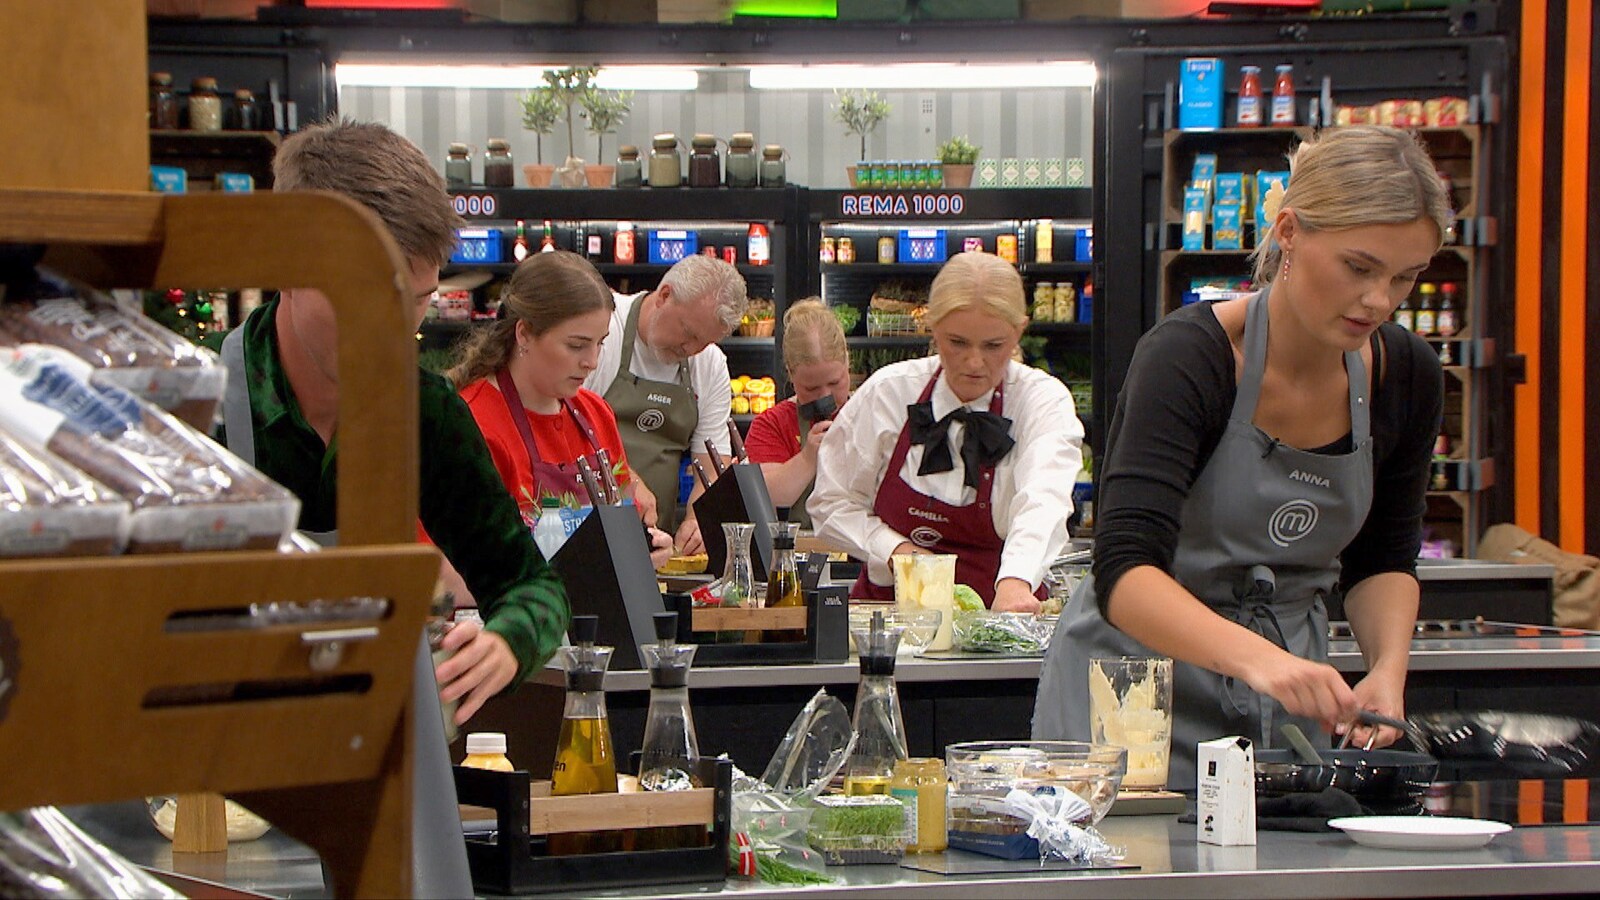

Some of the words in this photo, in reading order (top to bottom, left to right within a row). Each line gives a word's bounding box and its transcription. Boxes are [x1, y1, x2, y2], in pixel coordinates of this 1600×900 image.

[450, 195, 495, 216] 000
[843, 195, 908, 214] REMA
[913, 195, 963, 214] 1000
[647, 393, 672, 405] ASGER
[1289, 469, 1330, 488] ANNA
[564, 516, 587, 532] STR
